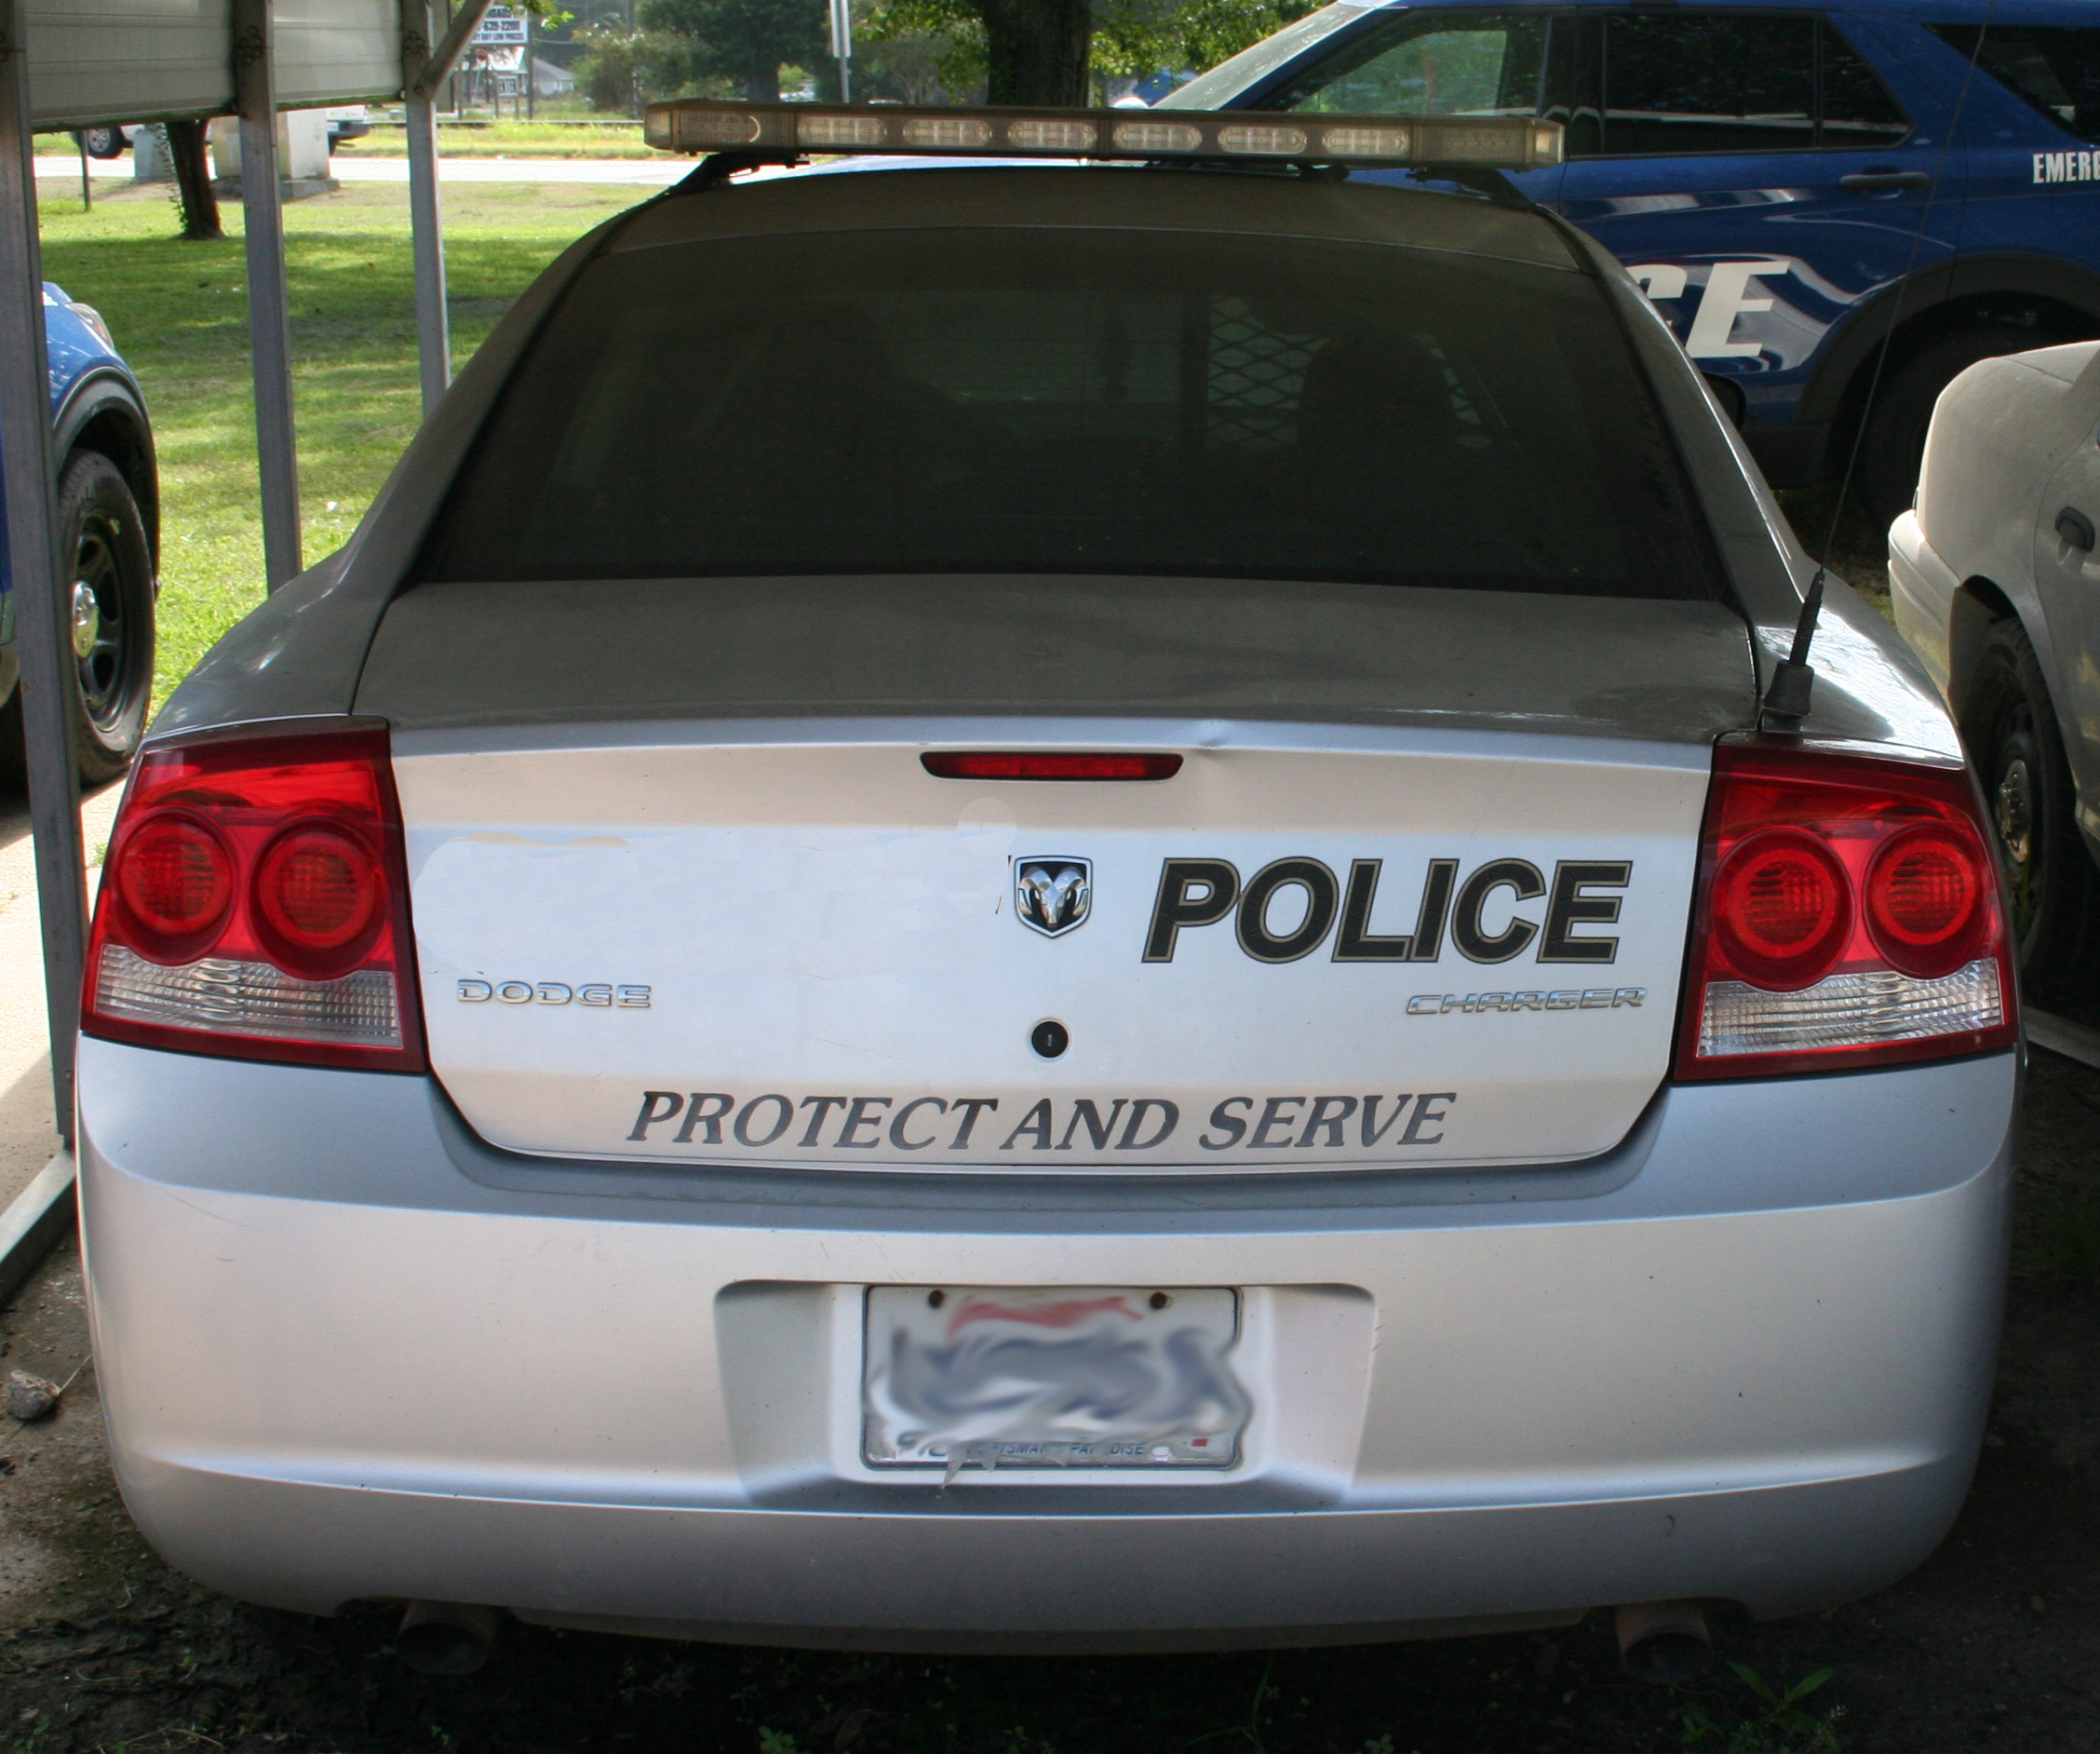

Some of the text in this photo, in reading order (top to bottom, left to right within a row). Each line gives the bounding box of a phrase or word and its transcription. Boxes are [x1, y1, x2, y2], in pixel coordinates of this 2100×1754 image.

[1141, 856, 1633, 965] POLICE
[456, 979, 652, 1008] DODGE
[1406, 987, 1647, 1016] CHARGER
[626, 1091, 1457, 1151] PROTECT AND SERVE
